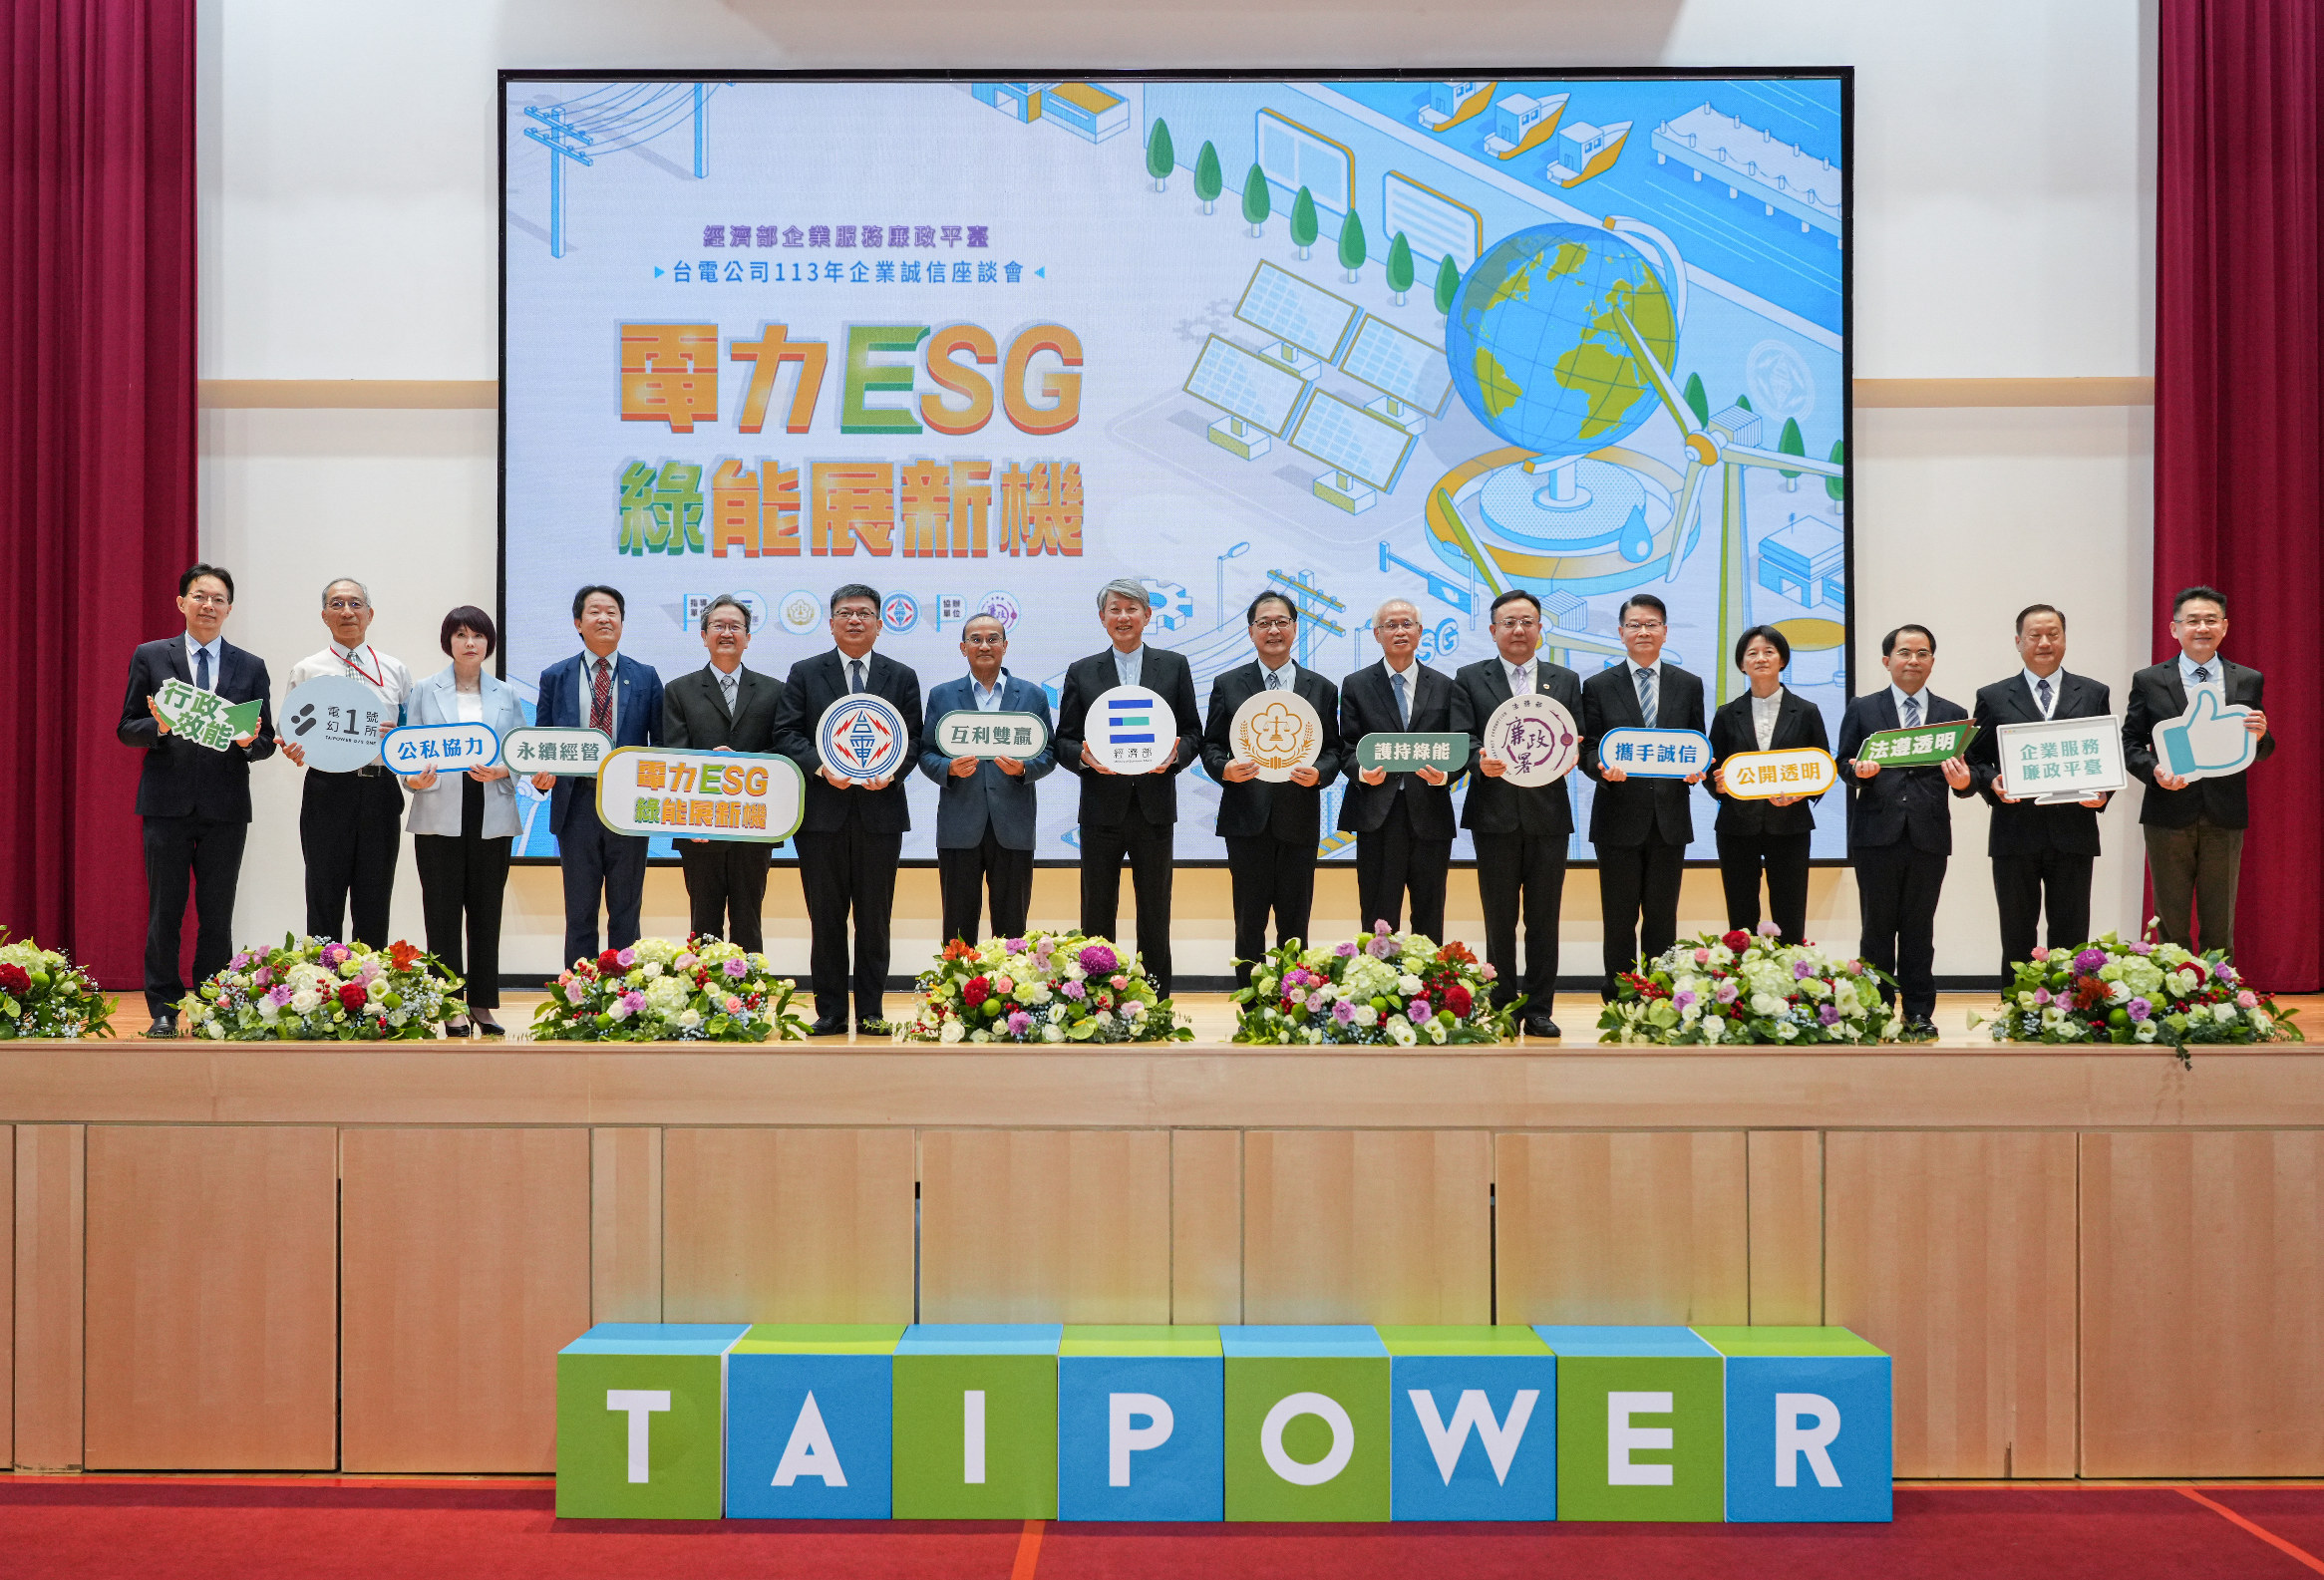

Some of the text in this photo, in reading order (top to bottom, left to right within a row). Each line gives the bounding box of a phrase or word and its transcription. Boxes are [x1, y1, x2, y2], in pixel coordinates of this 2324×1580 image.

[702, 224, 990, 248] 經濟部企業服務廉政平臺
[673, 260, 1024, 283] 台電公司113年企業誠信座談會
[618, 459, 1085, 558] 綠能展新機
[164, 681, 222, 721] 行政
[172, 711, 232, 750] 效能
[951, 726, 1032, 745] 互利雙贏
[399, 737, 484, 761] 公私協力
[516, 742, 600, 762] 永續經營
[1374, 743, 1451, 761] 護持綠能
[1615, 743, 1697, 764] 攜手誠信
[1868, 731, 1956, 760] 法遵透明
[2020, 739, 2100, 761] 企業服務
[1737, 762, 1821, 786] 公開透明
[2022, 759, 2103, 781] 廉政平臺
[634, 797, 767, 829] 綠能展新機
[606, 1390, 1842, 1487] TAIPOWER
